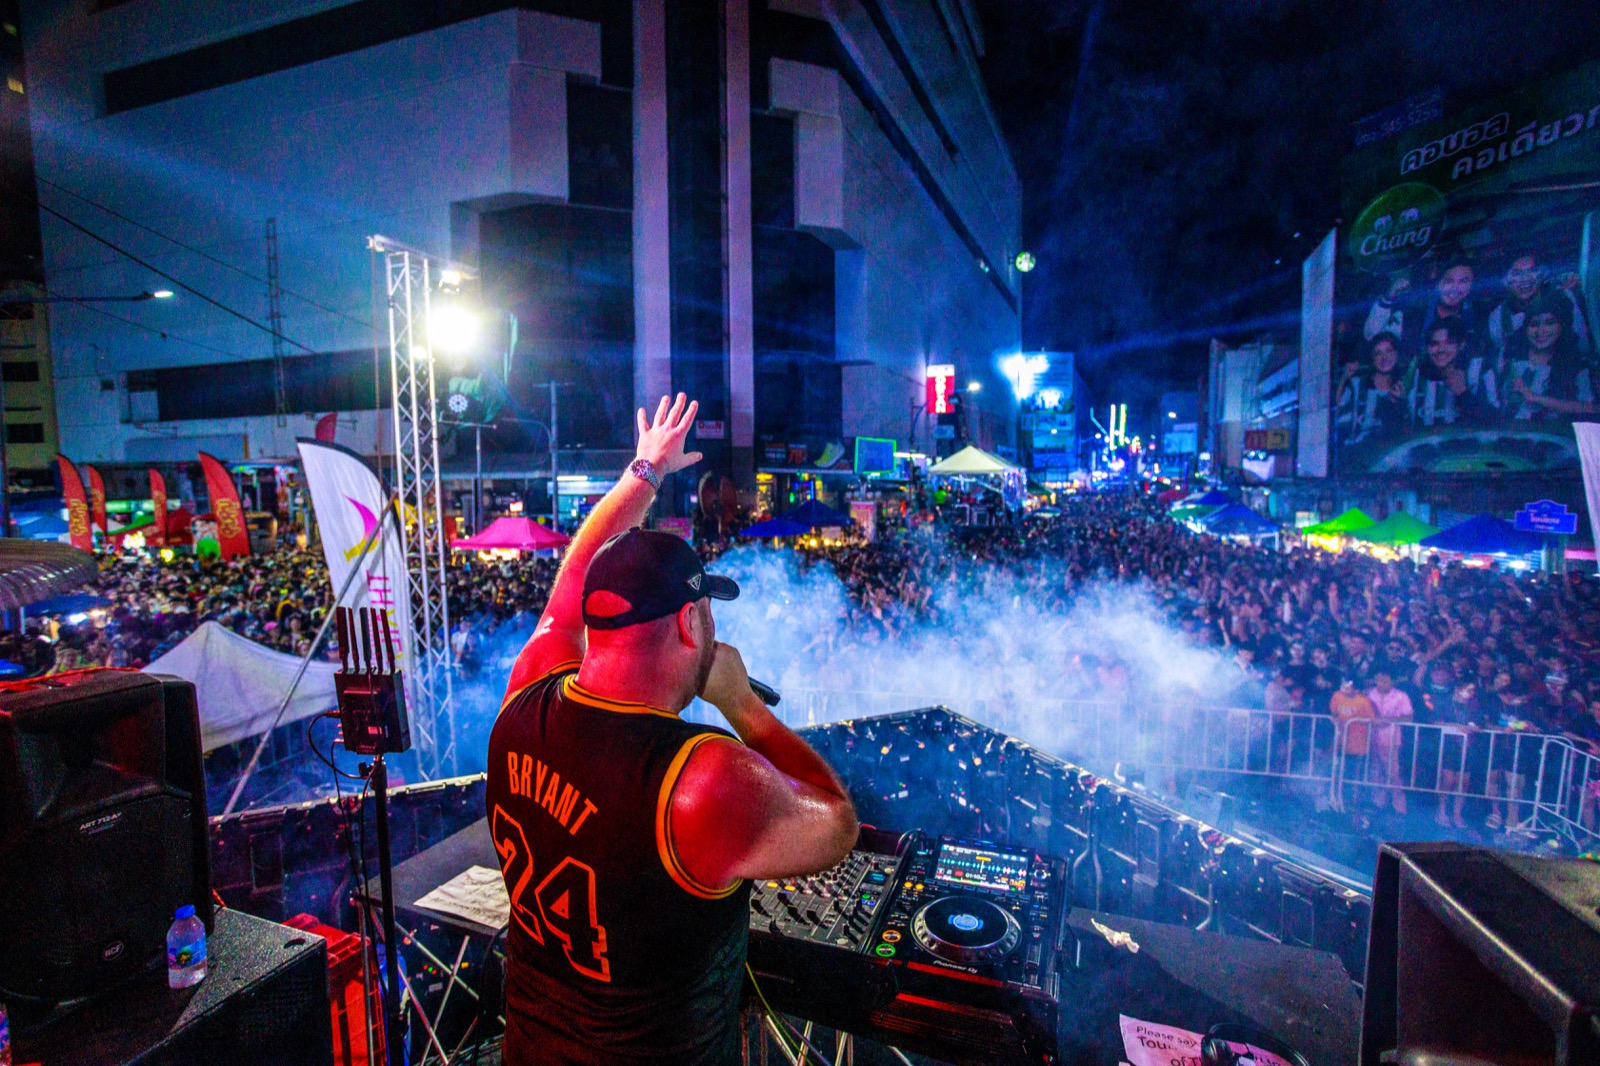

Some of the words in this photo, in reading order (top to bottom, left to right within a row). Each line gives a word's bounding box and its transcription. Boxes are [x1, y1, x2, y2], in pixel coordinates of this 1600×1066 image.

[1359, 225, 1431, 256] Chang
[507, 751, 598, 836] BRYANT
[492, 803, 611, 983] 24
[933, 959, 967, 972] Pioneer
[1136, 1026, 1174, 1041] Please
[1177, 1036, 1197, 1048] say
